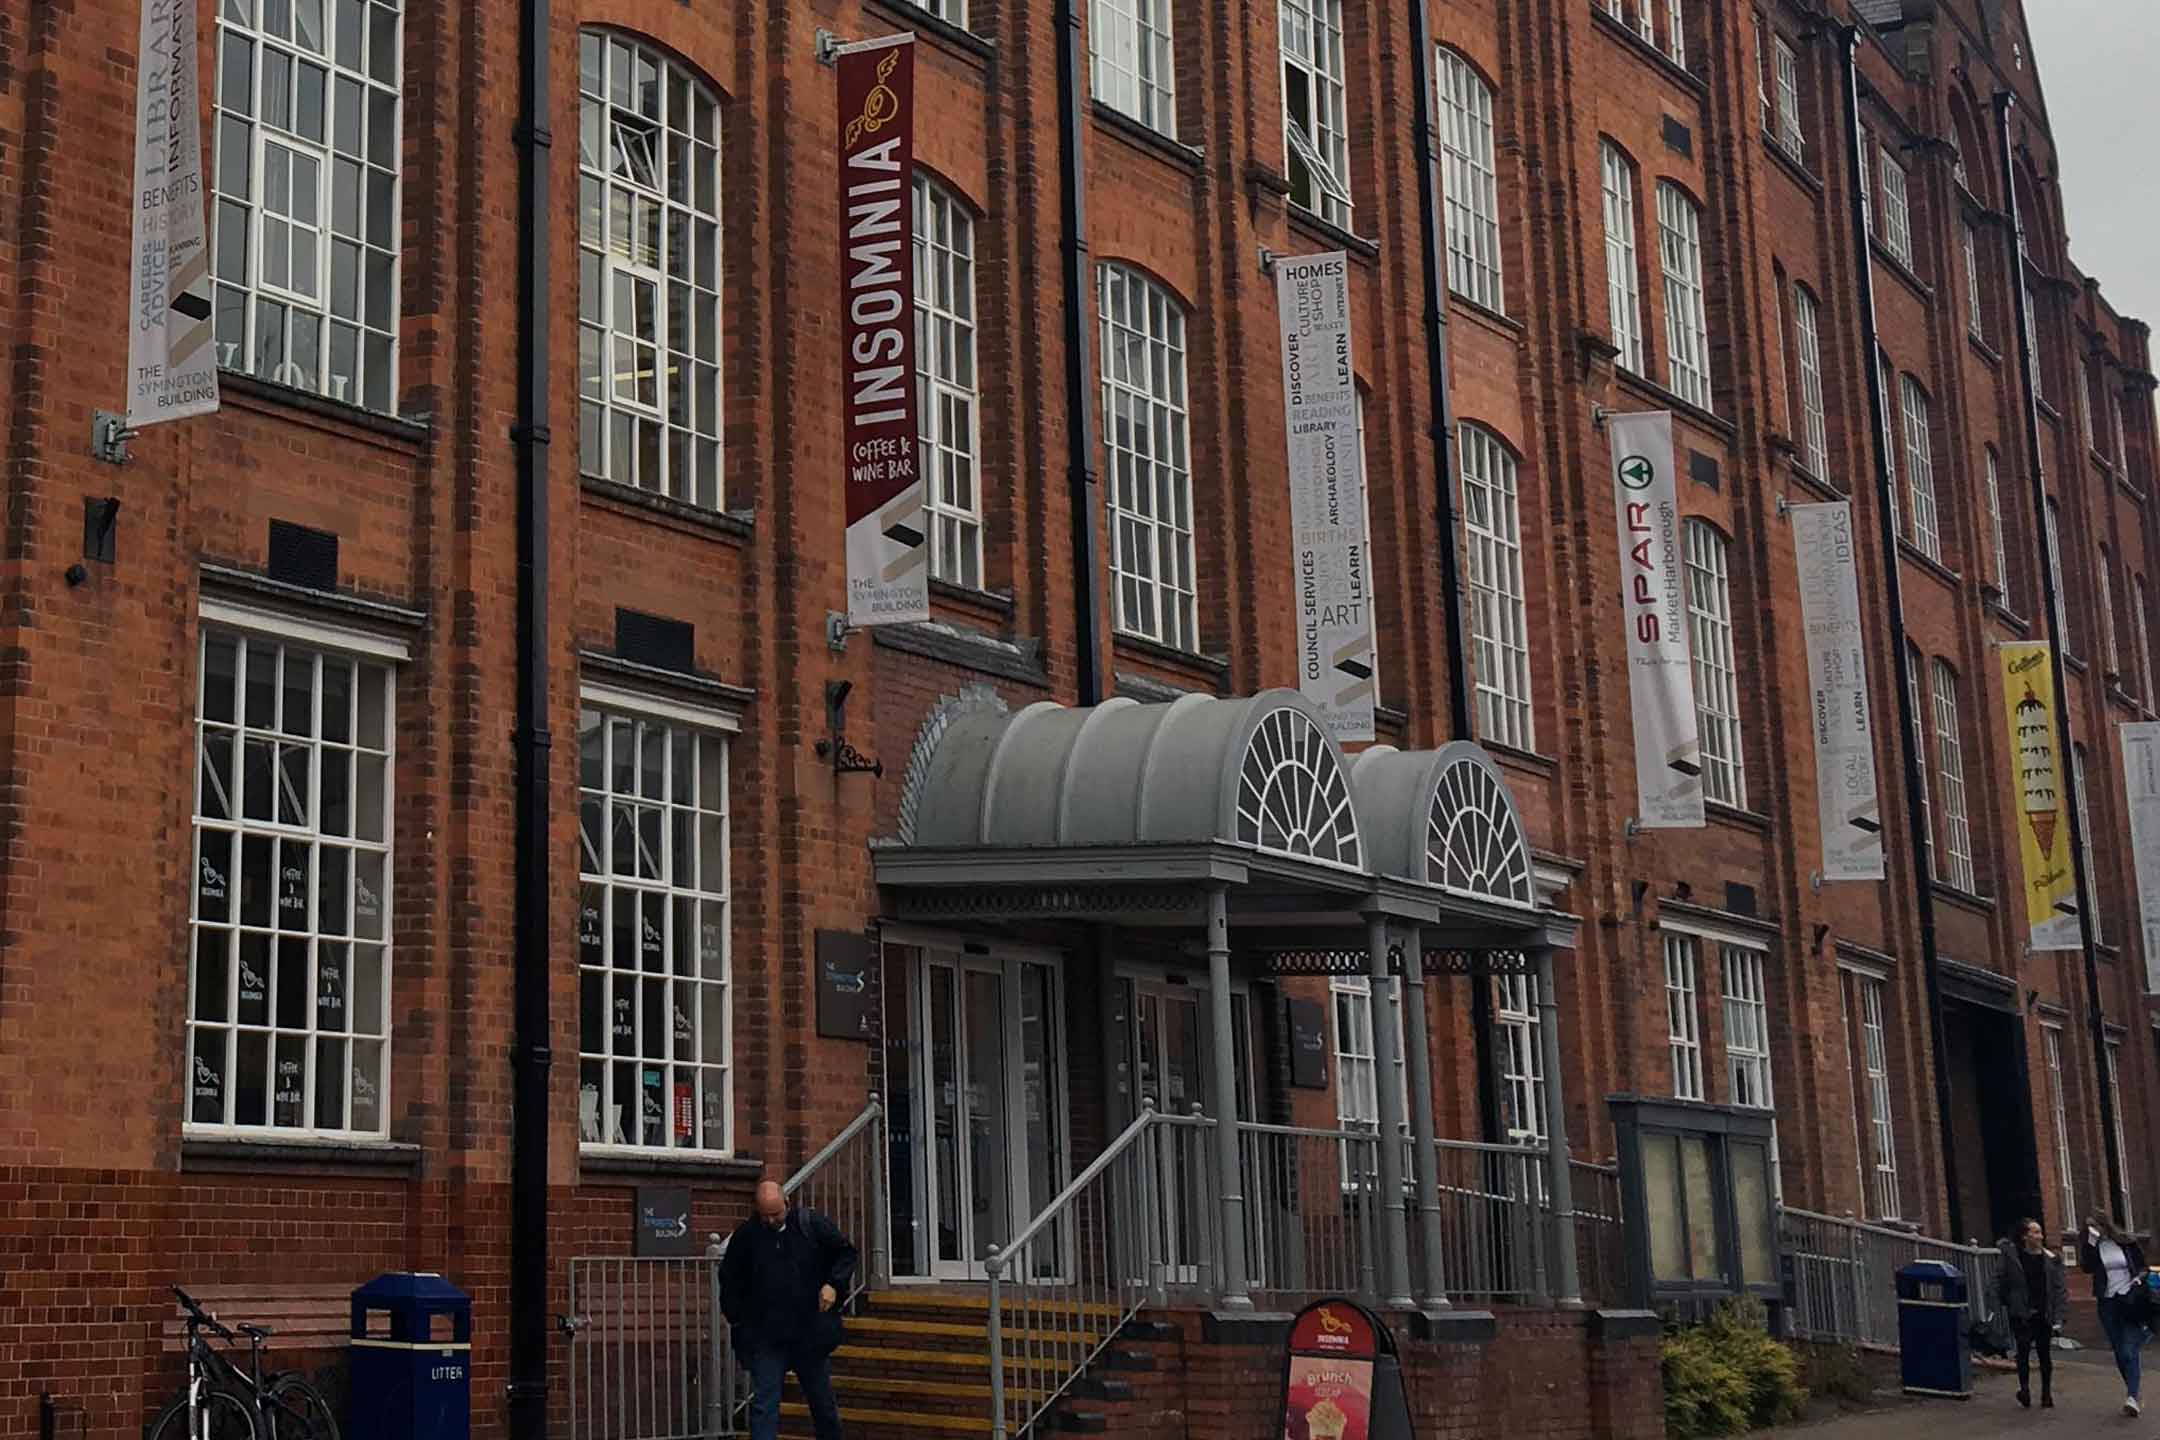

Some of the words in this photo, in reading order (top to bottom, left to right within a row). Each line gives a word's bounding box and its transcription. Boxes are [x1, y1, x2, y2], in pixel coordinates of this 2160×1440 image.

[142, 172, 198, 210] BENEFITS
[140, 242, 152, 331] CAREERS
[152, 239, 165, 327] ADVICE
[848, 136, 907, 426] INSOMNIA
[1286, 261, 1343, 280] HOMES
[1297, 280, 1312, 337] CULTURE
[1311, 279, 1324, 320] SHOP
[137, 364, 162, 380] THE
[1287, 333, 1302, 406] DISCOVER
[1336, 333, 1349, 386] LEARN
[136, 370, 214, 396] SYMINGTON
[158, 386, 215, 408] BUILDING
[1293, 404, 1352, 420] READING
[1293, 421, 1337, 435] LIBRARY
[852, 462, 885, 482] WINE
[888, 458, 914, 480] BAR
[853, 437, 897, 463] COFFEE
[1324, 434, 1338, 526] ARCHAEOLOGY
[1832, 509, 1850, 563] IDEAS
[852, 577, 875, 589] THE
[1302, 549, 1317, 616] SERVICES
[1348, 545, 1362, 600] LEARN
[1626, 502, 1660, 644] SPAR
[1320, 603, 1361, 627] ART
[1664, 592, 1681, 643] Market
[1305, 620, 1319, 680] COUNCIL
[1853, 690, 1866, 731] LEARN
[431, 1366, 463, 1380] LITTER
